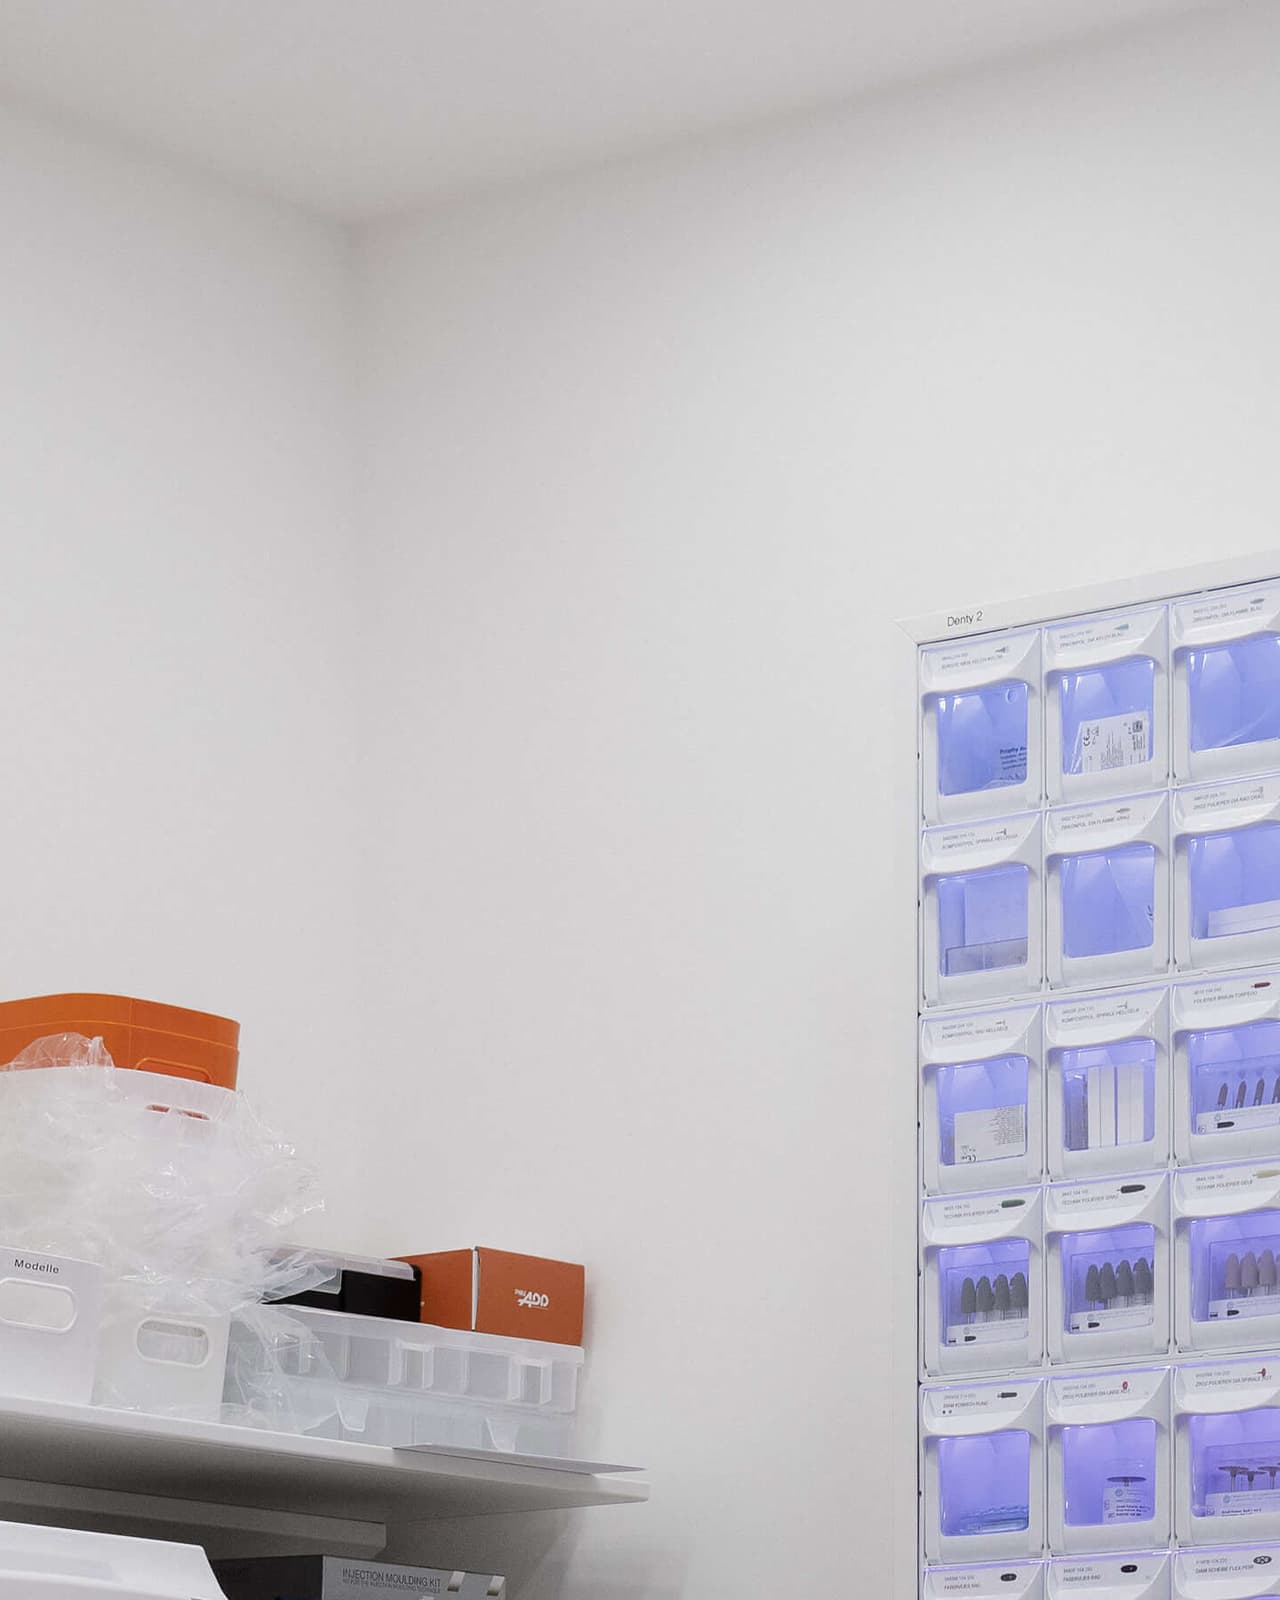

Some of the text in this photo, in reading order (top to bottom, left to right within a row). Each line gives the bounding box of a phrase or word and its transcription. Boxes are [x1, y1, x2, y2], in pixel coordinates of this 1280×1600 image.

[947, 610, 983, 627] Denty 2
[14, 1257, 60, 1274] Modelle
[342, 1567, 385, 1582] INJECTION
[386, 1573, 428, 1587] MOULDING
[429, 1576, 441, 1588] KIT
